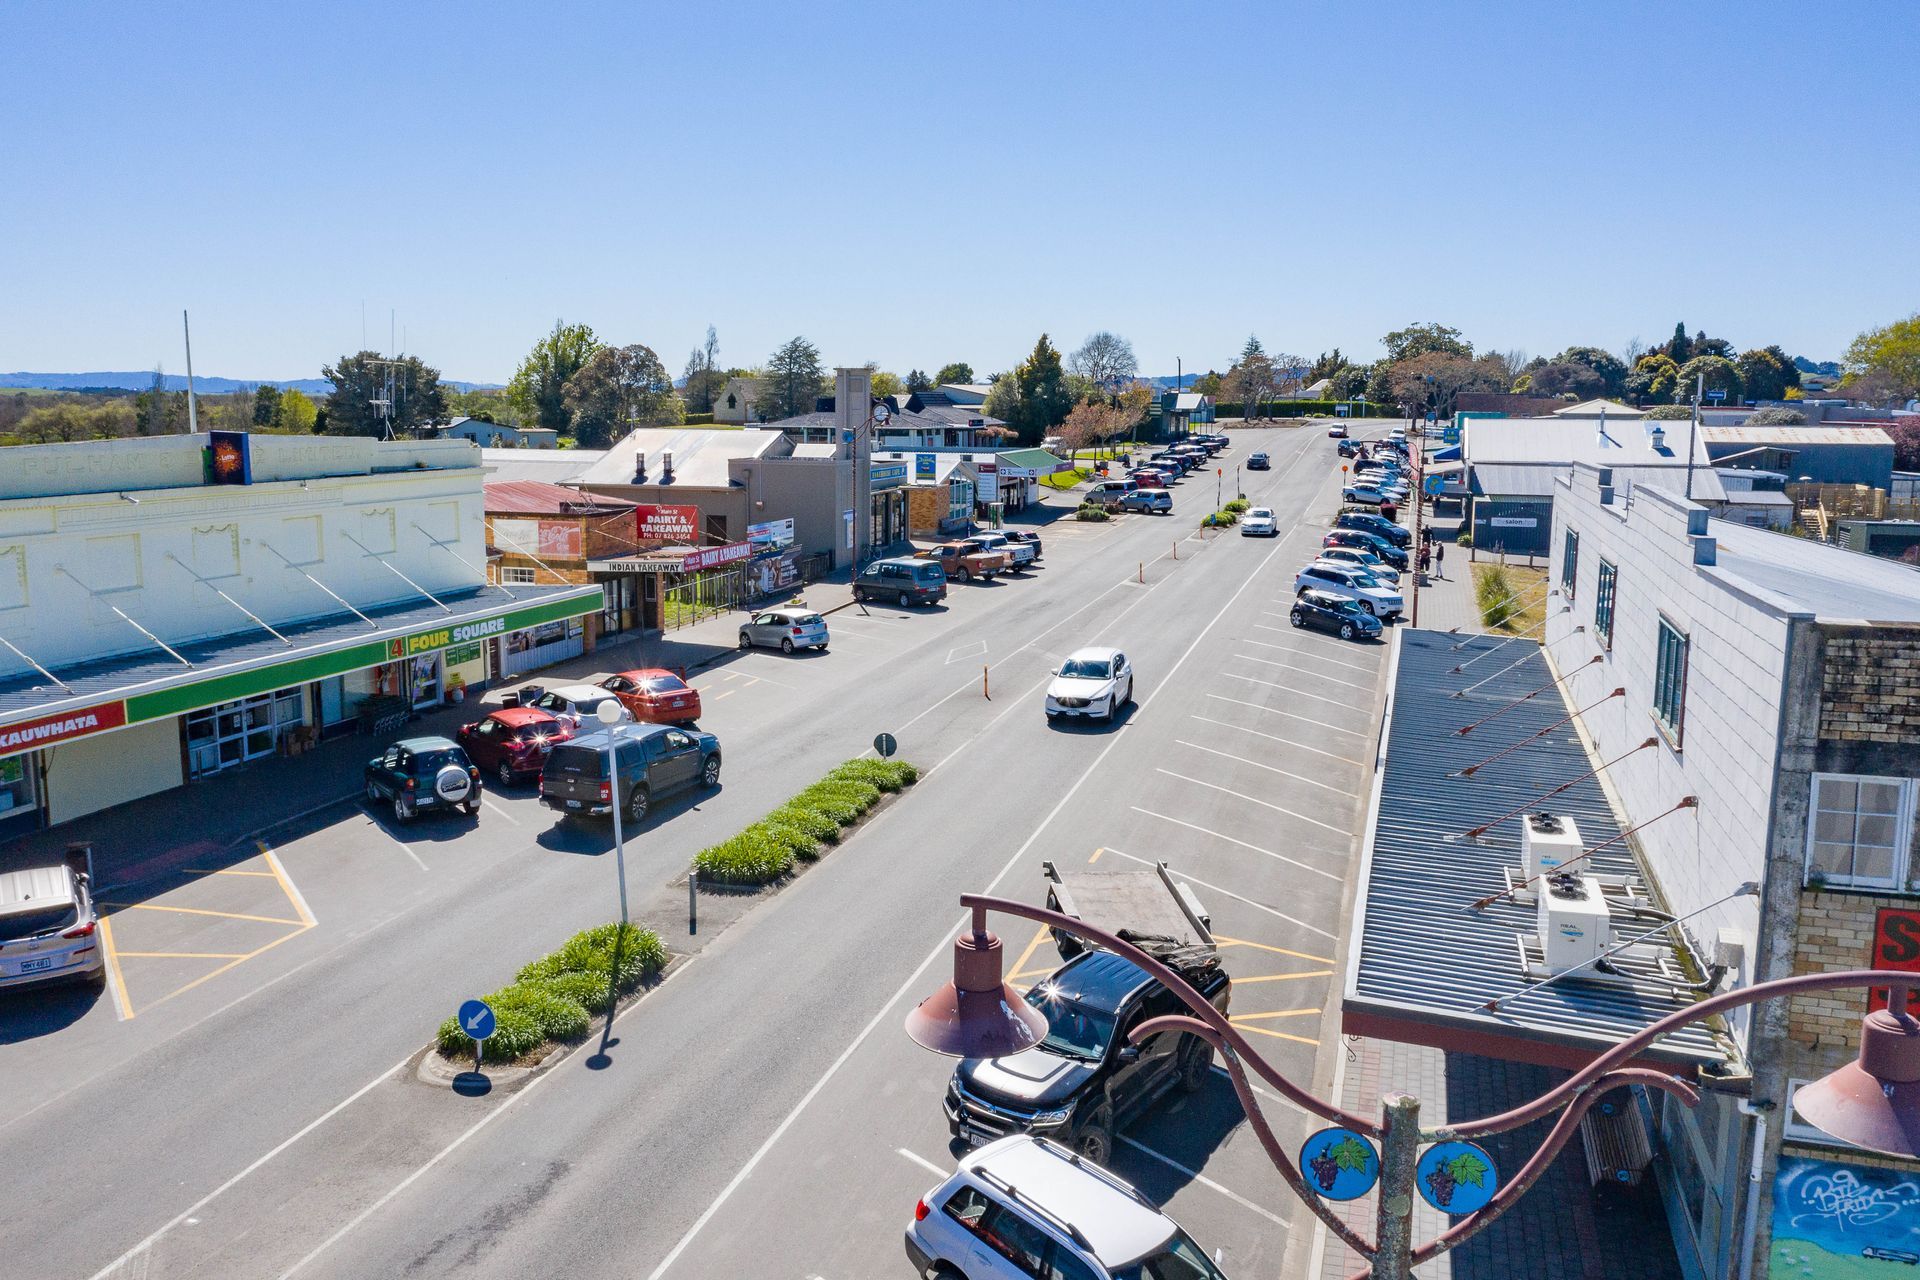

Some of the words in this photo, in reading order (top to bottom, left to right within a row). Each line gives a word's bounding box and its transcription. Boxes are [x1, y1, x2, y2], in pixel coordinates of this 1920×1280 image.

[647, 515, 677, 524] DAIRY
[680, 516, 687, 524] &
[641, 524, 694, 533] TAKEAWAY
[701, 550, 719, 567] DAIRY
[723, 543, 750, 560] TAKEAWAY
[609, 563, 636, 571] INDIAN
[638, 563, 680, 572] TAKEAWAY
[391, 639, 404, 657] 4
[409, 630, 450, 652] FOUR
[453, 618, 504, 641] SQUARE
